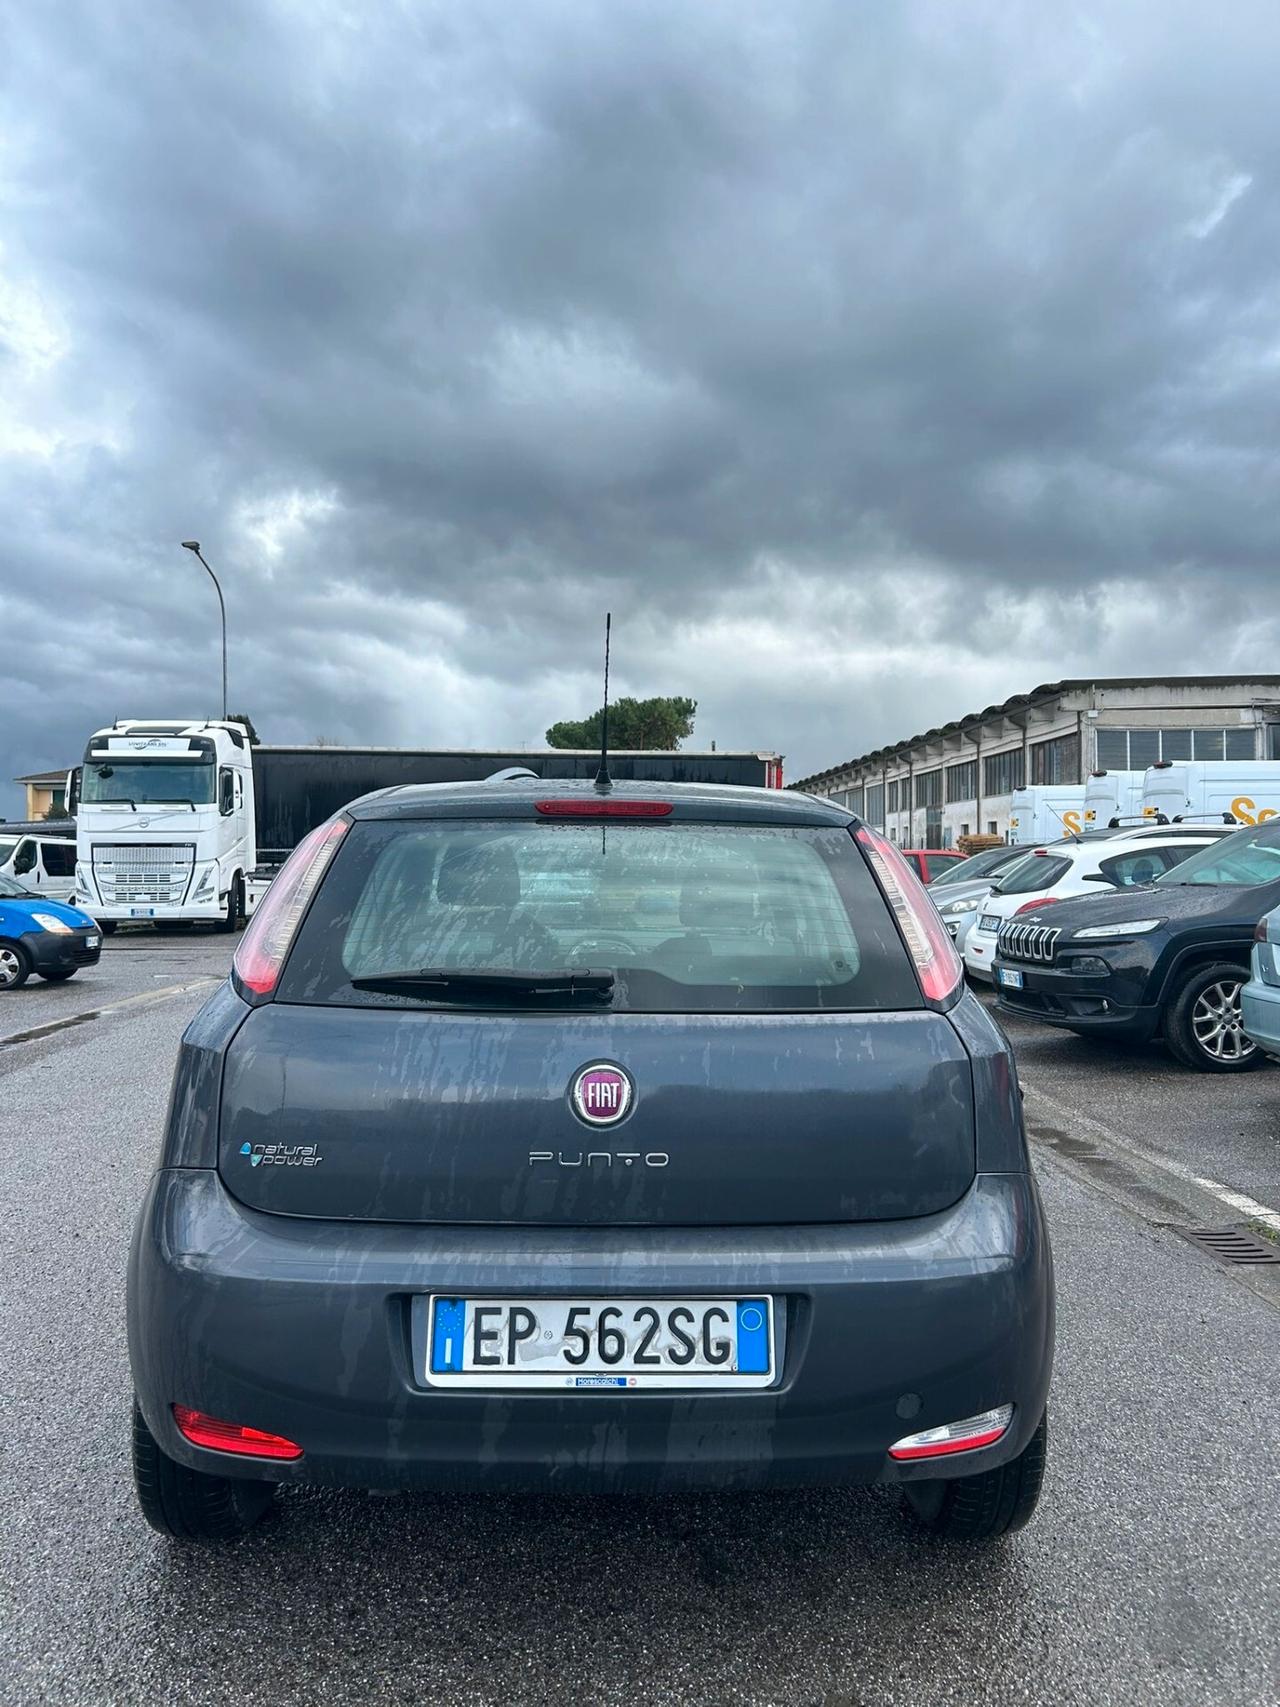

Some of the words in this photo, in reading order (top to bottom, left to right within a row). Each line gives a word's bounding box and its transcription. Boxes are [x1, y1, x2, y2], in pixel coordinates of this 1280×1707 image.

[588, 1082, 620, 1108] FIAT
[253, 1142, 318, 1156] natural
[261, 1155, 323, 1166] power
[529, 1151, 669, 1167] PUNTO
[472, 1306, 537, 1366] EP
[563, 1306, 732, 1366] 562SG
